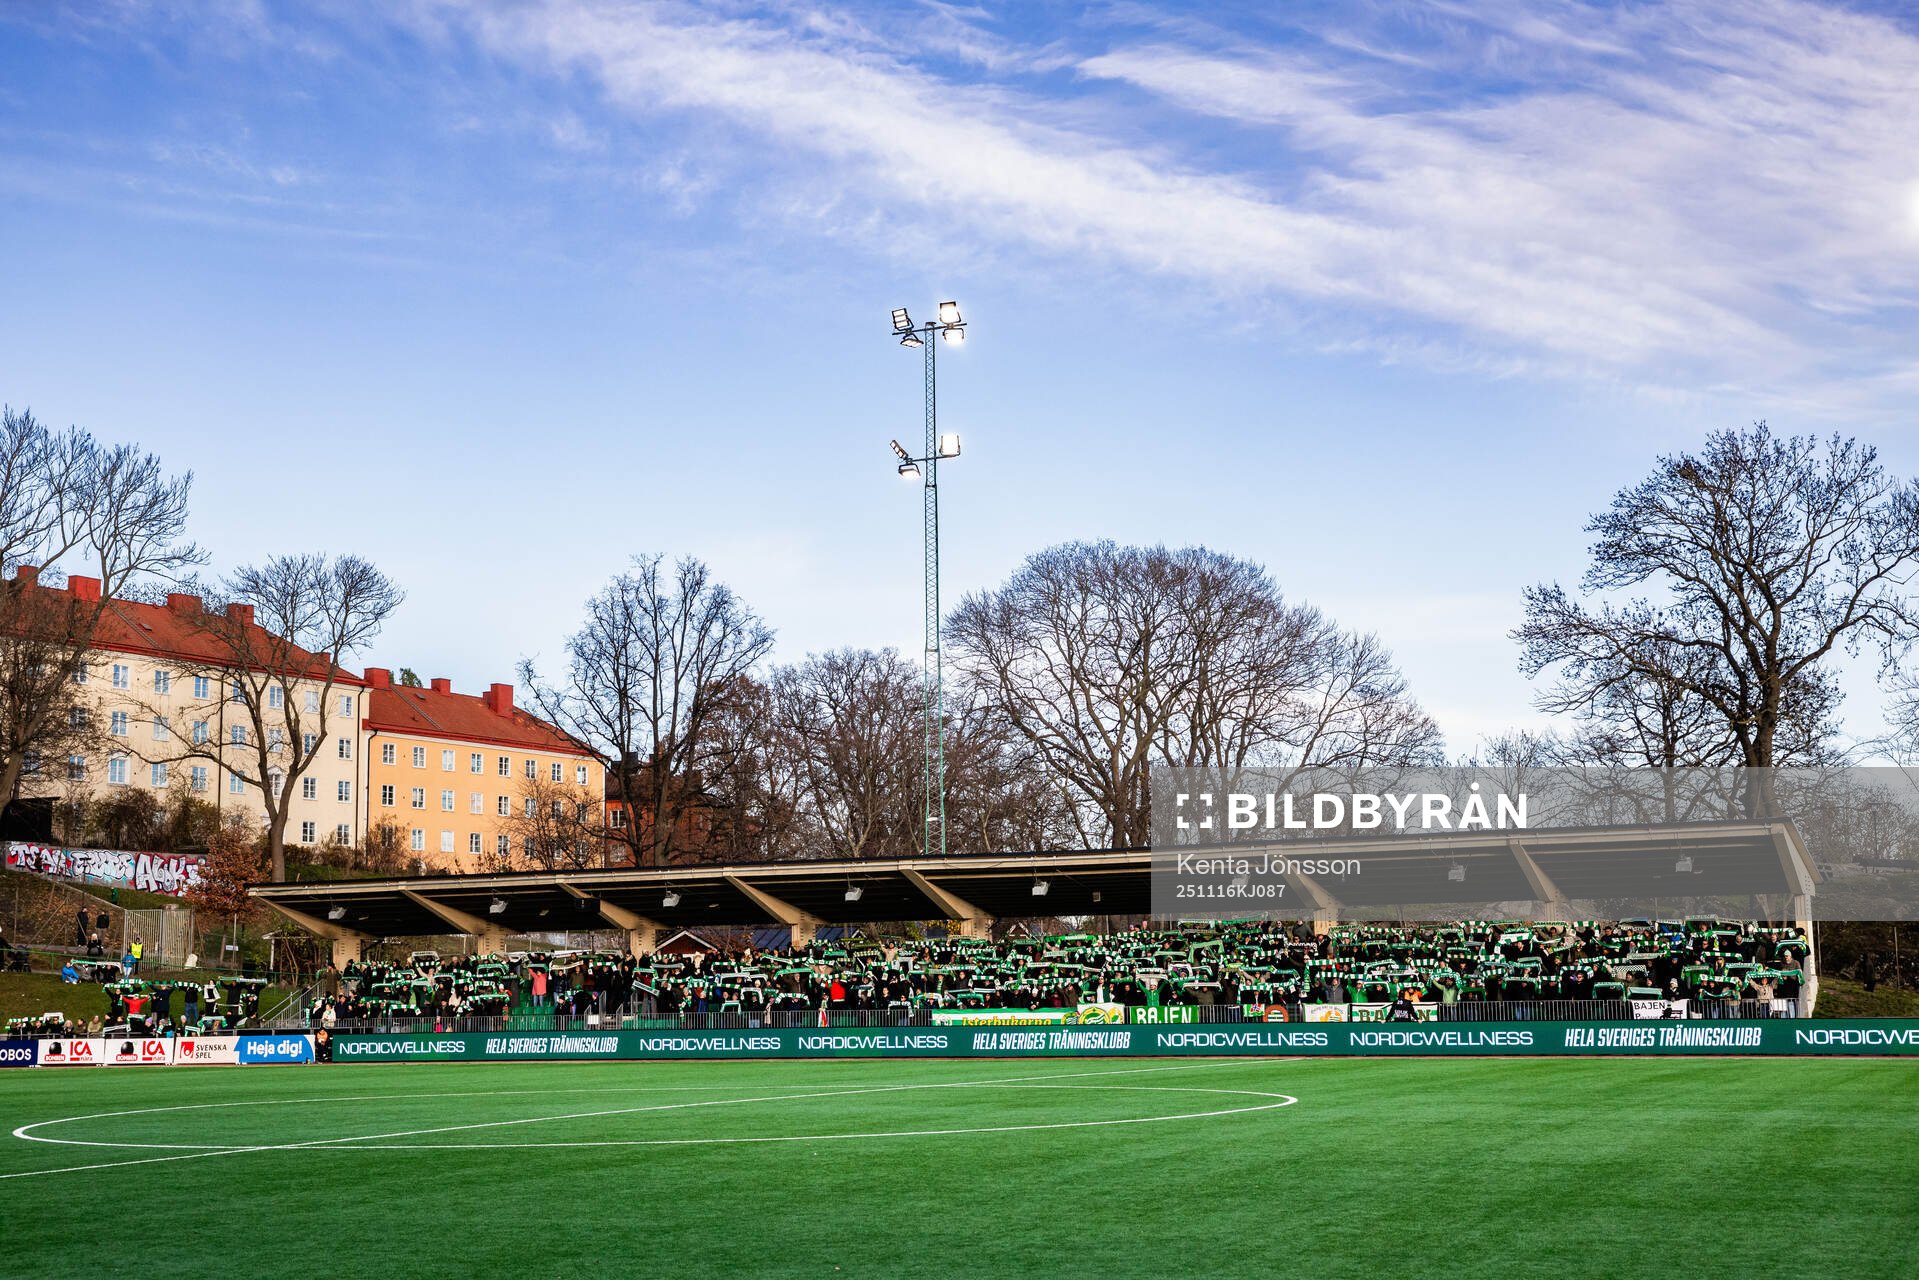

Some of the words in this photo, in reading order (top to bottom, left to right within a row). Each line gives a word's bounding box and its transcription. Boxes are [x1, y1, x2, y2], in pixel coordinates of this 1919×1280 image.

[1634, 1002, 1665, 1010] BAJEN
[1136, 1006, 1192, 1024] BAJEN
[1357, 1009, 1431, 1023] BAN
[798, 1035, 948, 1050] NORDICWELLNESS
[972, 1033, 998, 1050] HELA
[998, 1032, 1047, 1050] SVERIGES
[1048, 1029, 1131, 1049] TRÄNINGSKLUBB
[1157, 1032, 1329, 1047] NORDICWELLNESS
[1349, 1031, 1534, 1046] NORDICWELLNESS
[1564, 1028, 1595, 1047] HELA
[1597, 1028, 1656, 1047] SVERIGES
[1659, 1025, 1761, 1047] TRÄNINGSKLUBB
[1795, 1029, 1919, 1045] NORDICWE
[70, 1041, 93, 1056] ICA
[142, 1041, 165, 1055] ICA
[196, 1044, 227, 1052] SVENSKA
[247, 1041, 275, 1057] Heja
[277, 1039, 303, 1058] dig!
[339, 1040, 466, 1055] NORDICWELLNESS
[485, 1038, 507, 1054] HELA
[507, 1038, 548, 1054] SVERIGES
[549, 1035, 619, 1053] TRÄNINGSKLUBB
[639, 1037, 781, 1051] NORDICWELLNESS
[0, 1048, 32, 1061] OBOS
